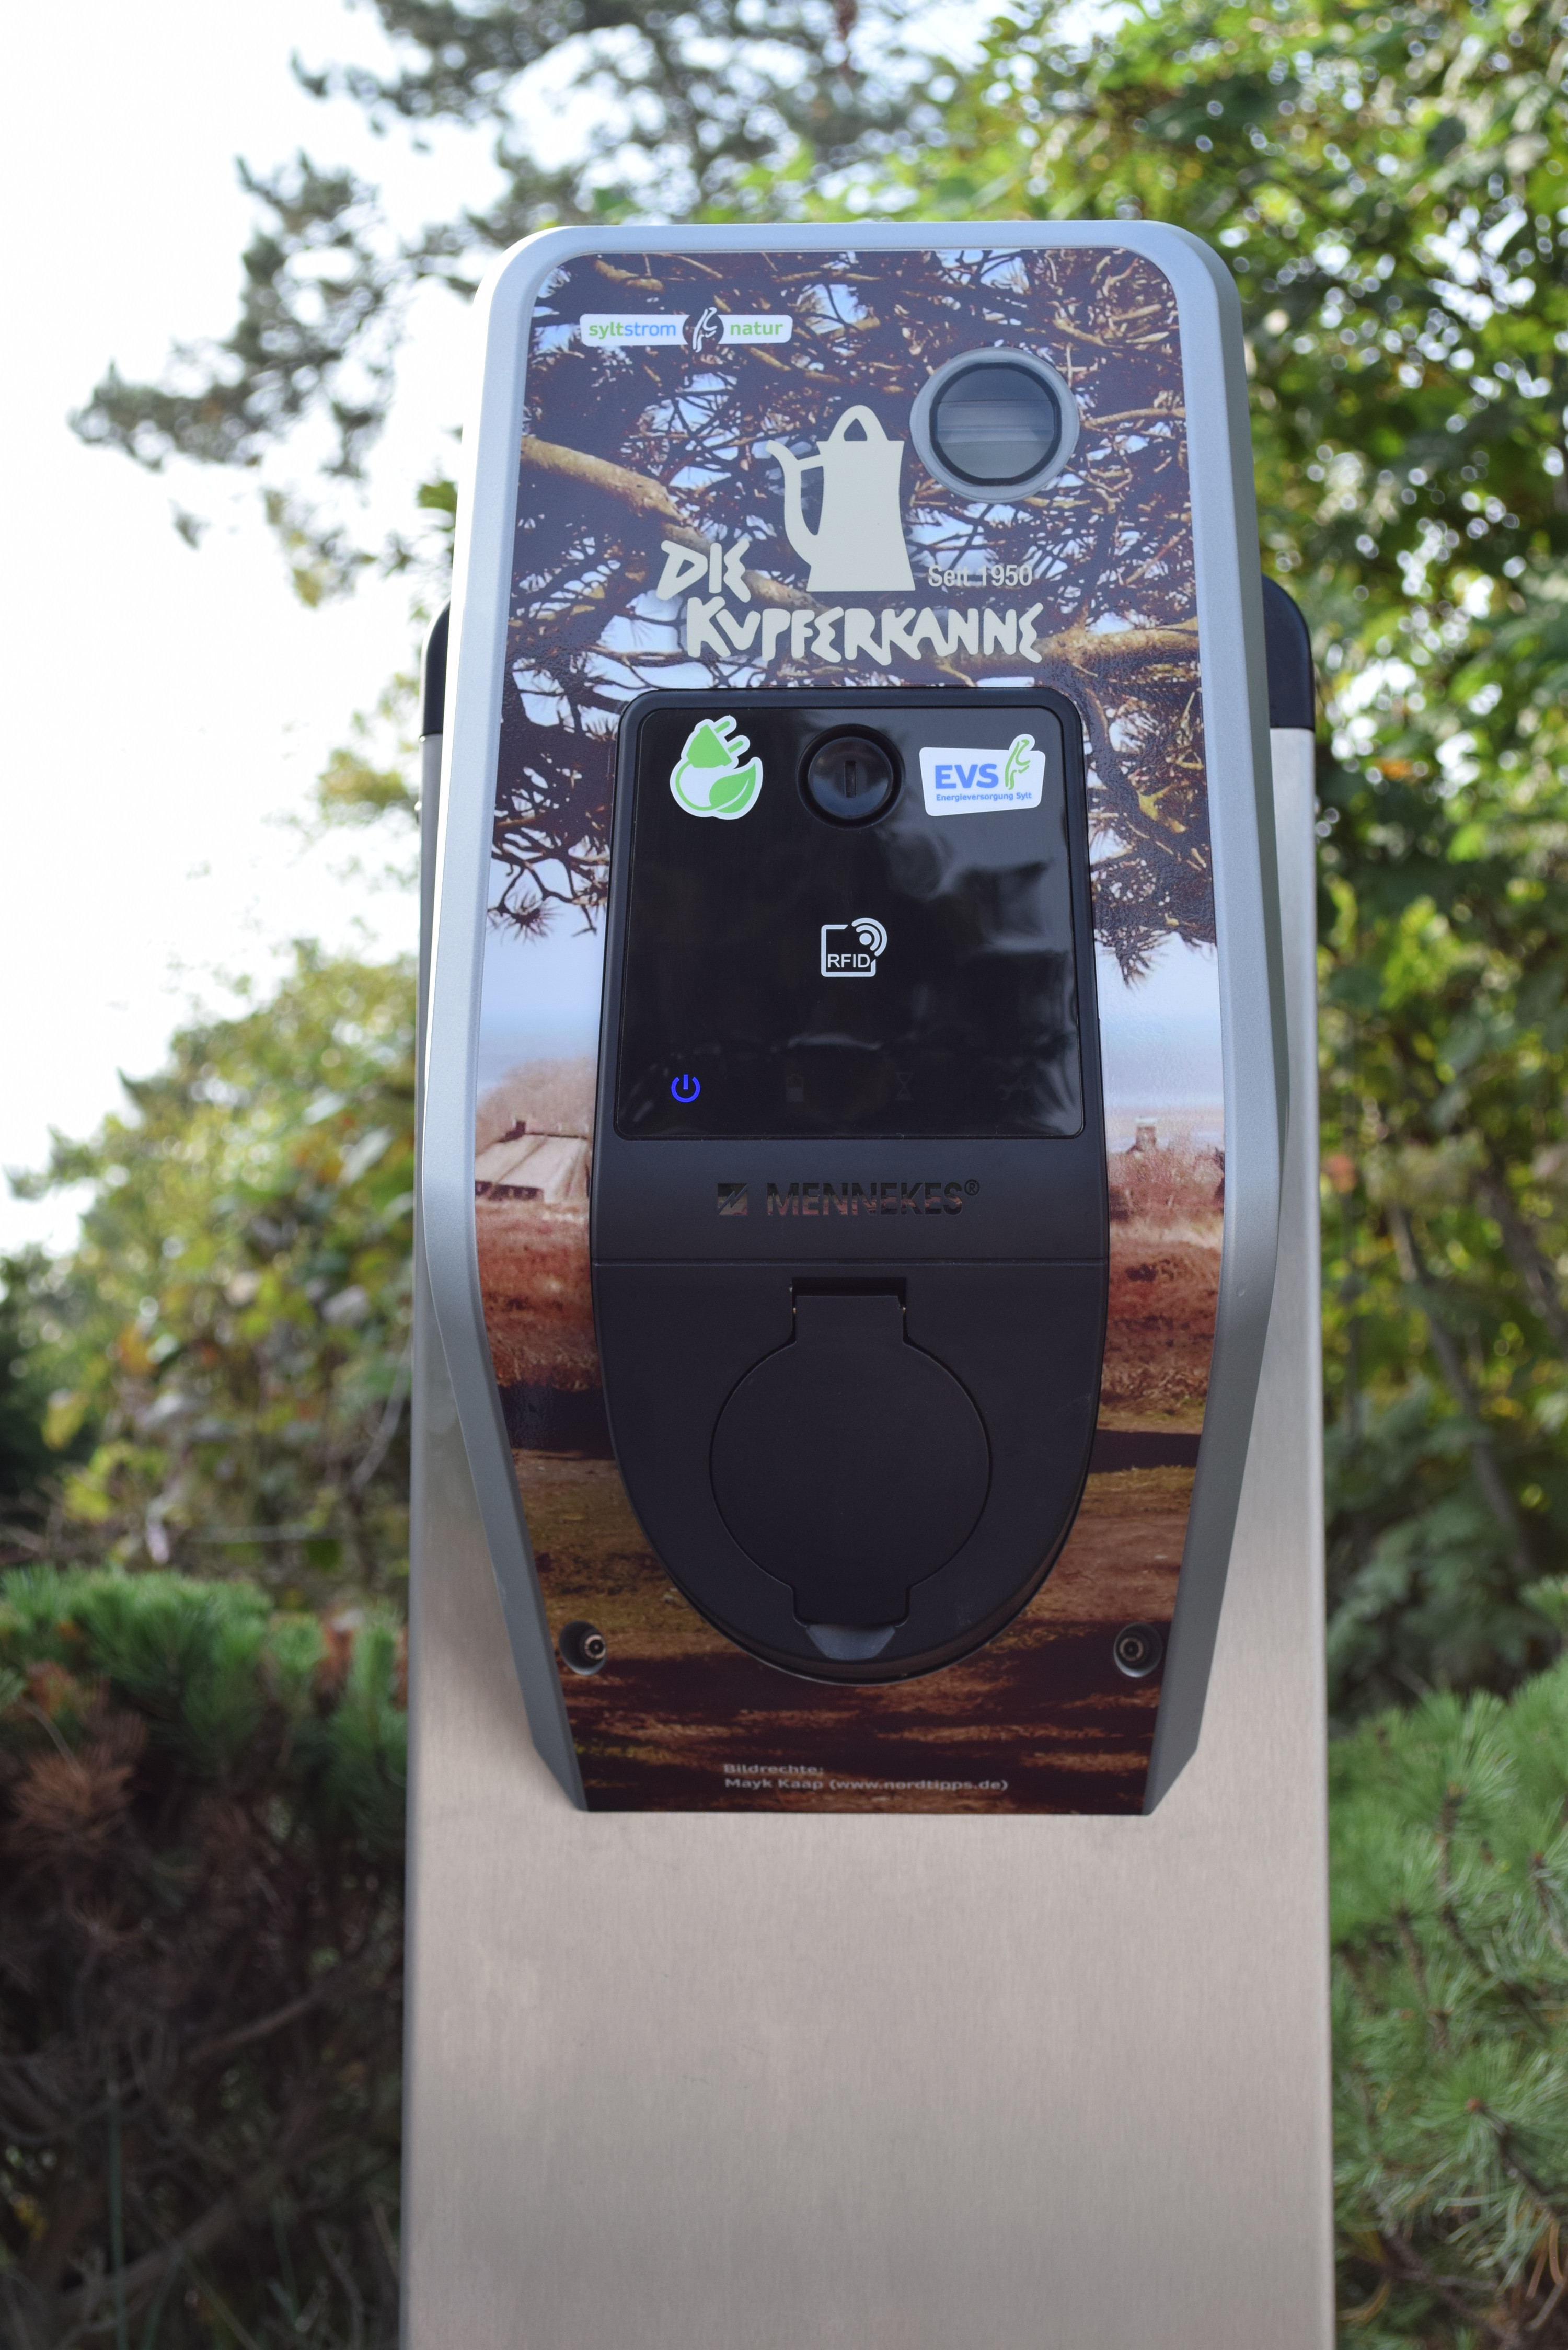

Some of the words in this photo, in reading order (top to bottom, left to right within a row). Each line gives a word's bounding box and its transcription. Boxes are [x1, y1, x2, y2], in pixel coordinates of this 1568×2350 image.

[589, 321, 677, 340] syltstrom
[730, 321, 783, 336] natur
[655, 538, 752, 604] DIE
[928, 564, 970, 587] Seit
[981, 564, 1033, 587] 1950
[935, 763, 999, 789] EVS
[936, 793, 1014, 802] Energieversorgung
[1016, 792, 1032, 801] Sylt
[827, 953, 871, 968] RFID
[723, 1763, 825, 1775] Bildrechte:
[724, 1778, 773, 1791] Mayk
[777, 1778, 824, 1791] Kaap
